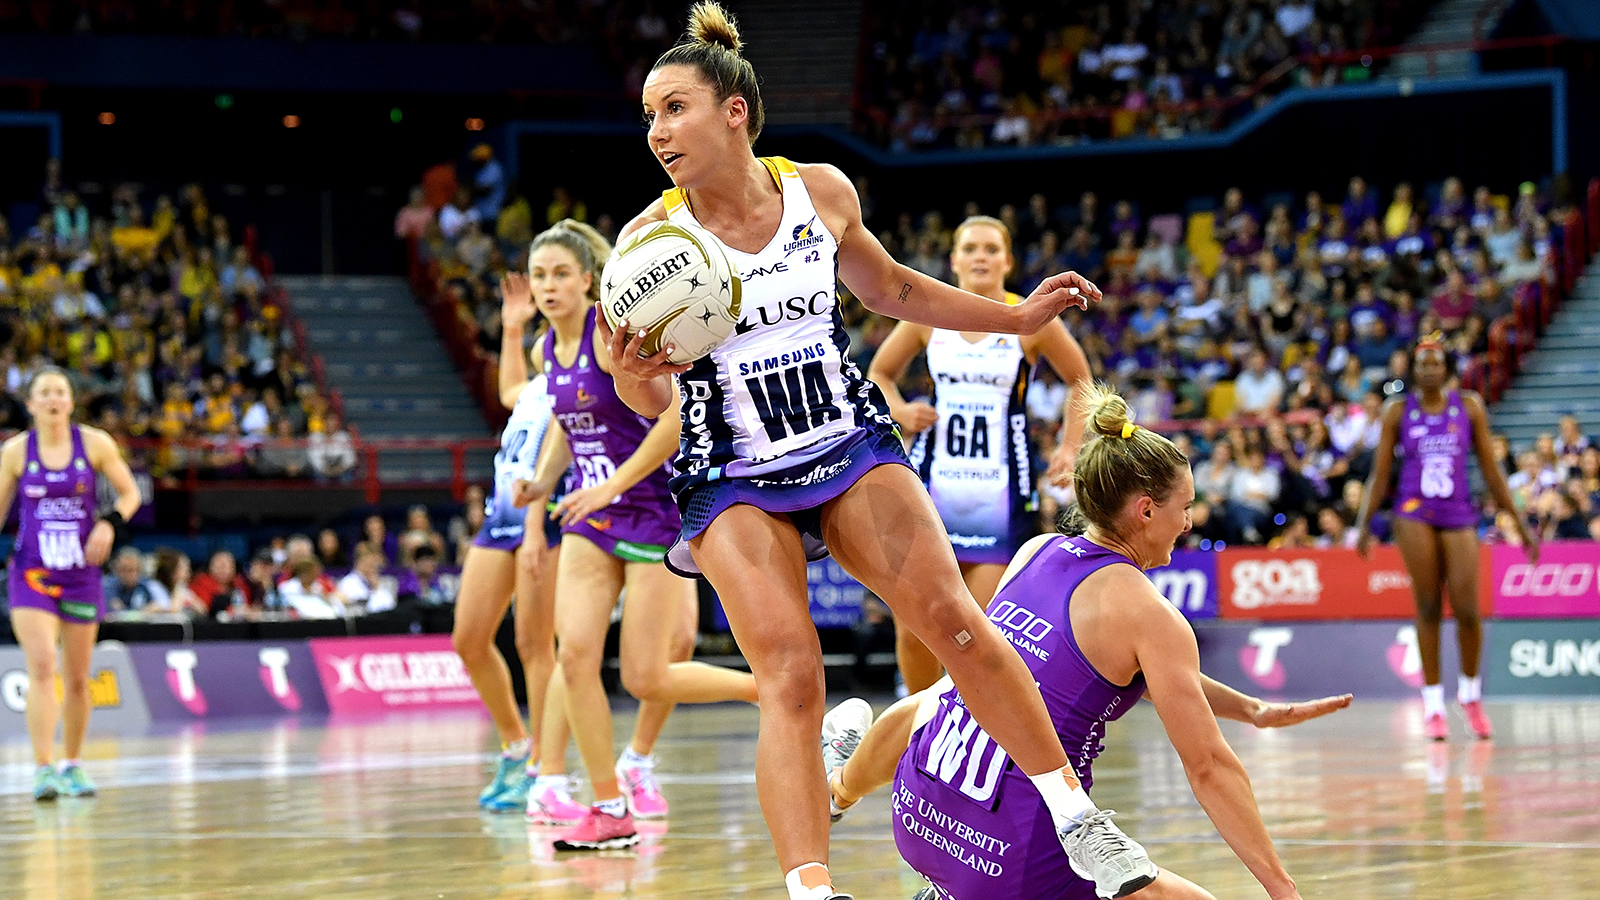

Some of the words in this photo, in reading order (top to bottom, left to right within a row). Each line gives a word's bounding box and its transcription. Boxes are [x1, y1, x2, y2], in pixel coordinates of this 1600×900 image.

[784, 235, 824, 252] LIGHTNING
[804, 250, 821, 263] #2
[613, 251, 692, 318] GILBERT
[756, 291, 829, 326] USC
[739, 343, 826, 377] SAMSUNG
[745, 361, 842, 443] WA
[947, 414, 990, 458] GA
[1057, 540, 1087, 558] BLK
[360, 651, 471, 692] GILBER
[924, 704, 1008, 802] WD
[901, 812, 1003, 878] QUEENSLAND
[917, 797, 1012, 857] UNIVERSITY
